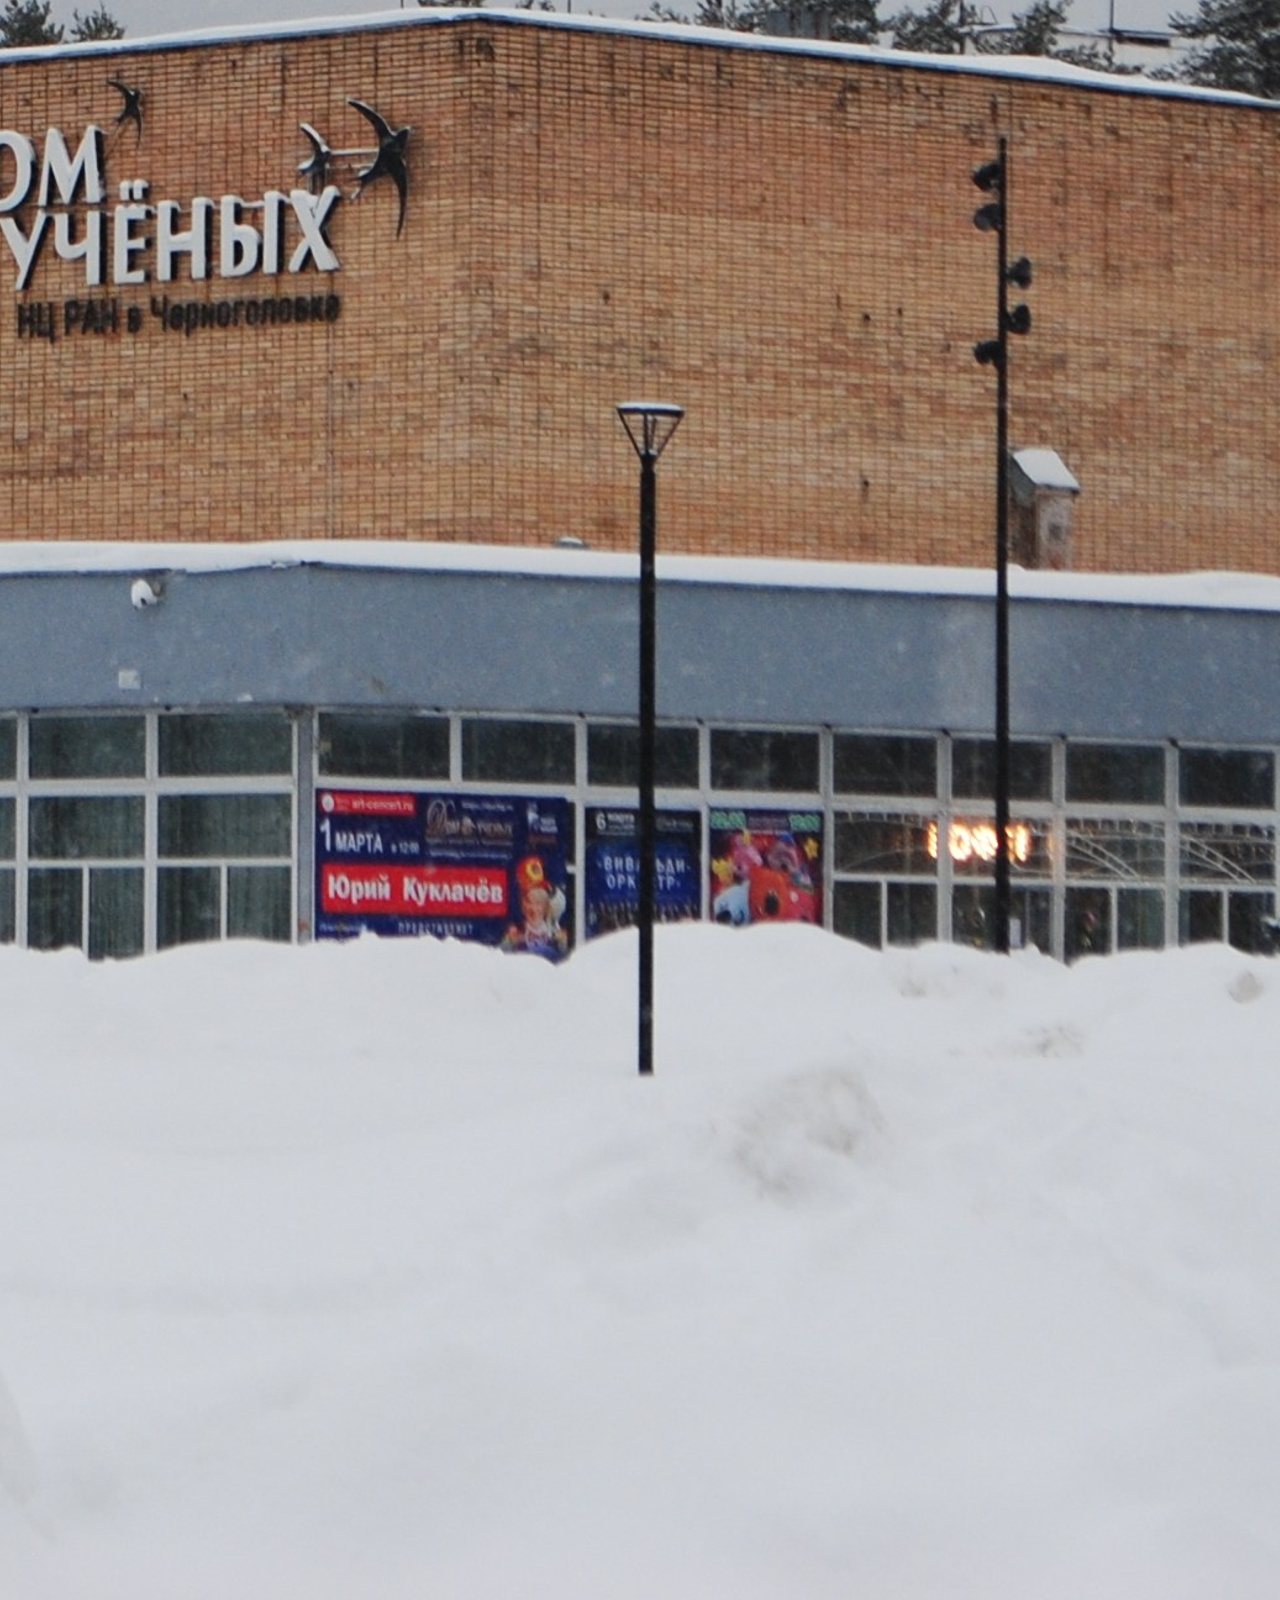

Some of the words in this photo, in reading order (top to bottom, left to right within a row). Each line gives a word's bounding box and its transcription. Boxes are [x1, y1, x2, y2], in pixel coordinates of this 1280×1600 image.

[0, 179, 340, 290] УЧЁНЫХ
[17, 302, 55, 343] НЦ
[64, 298, 119, 337] РАН
[126, 305, 142, 334] в
[149, 291, 342, 338] Черноголовке
[319, 818, 331, 853] 1
[334, 831, 384, 855] МАРТА
[327, 872, 391, 904] Юрий
[402, 874, 504, 907] Куклачёв
